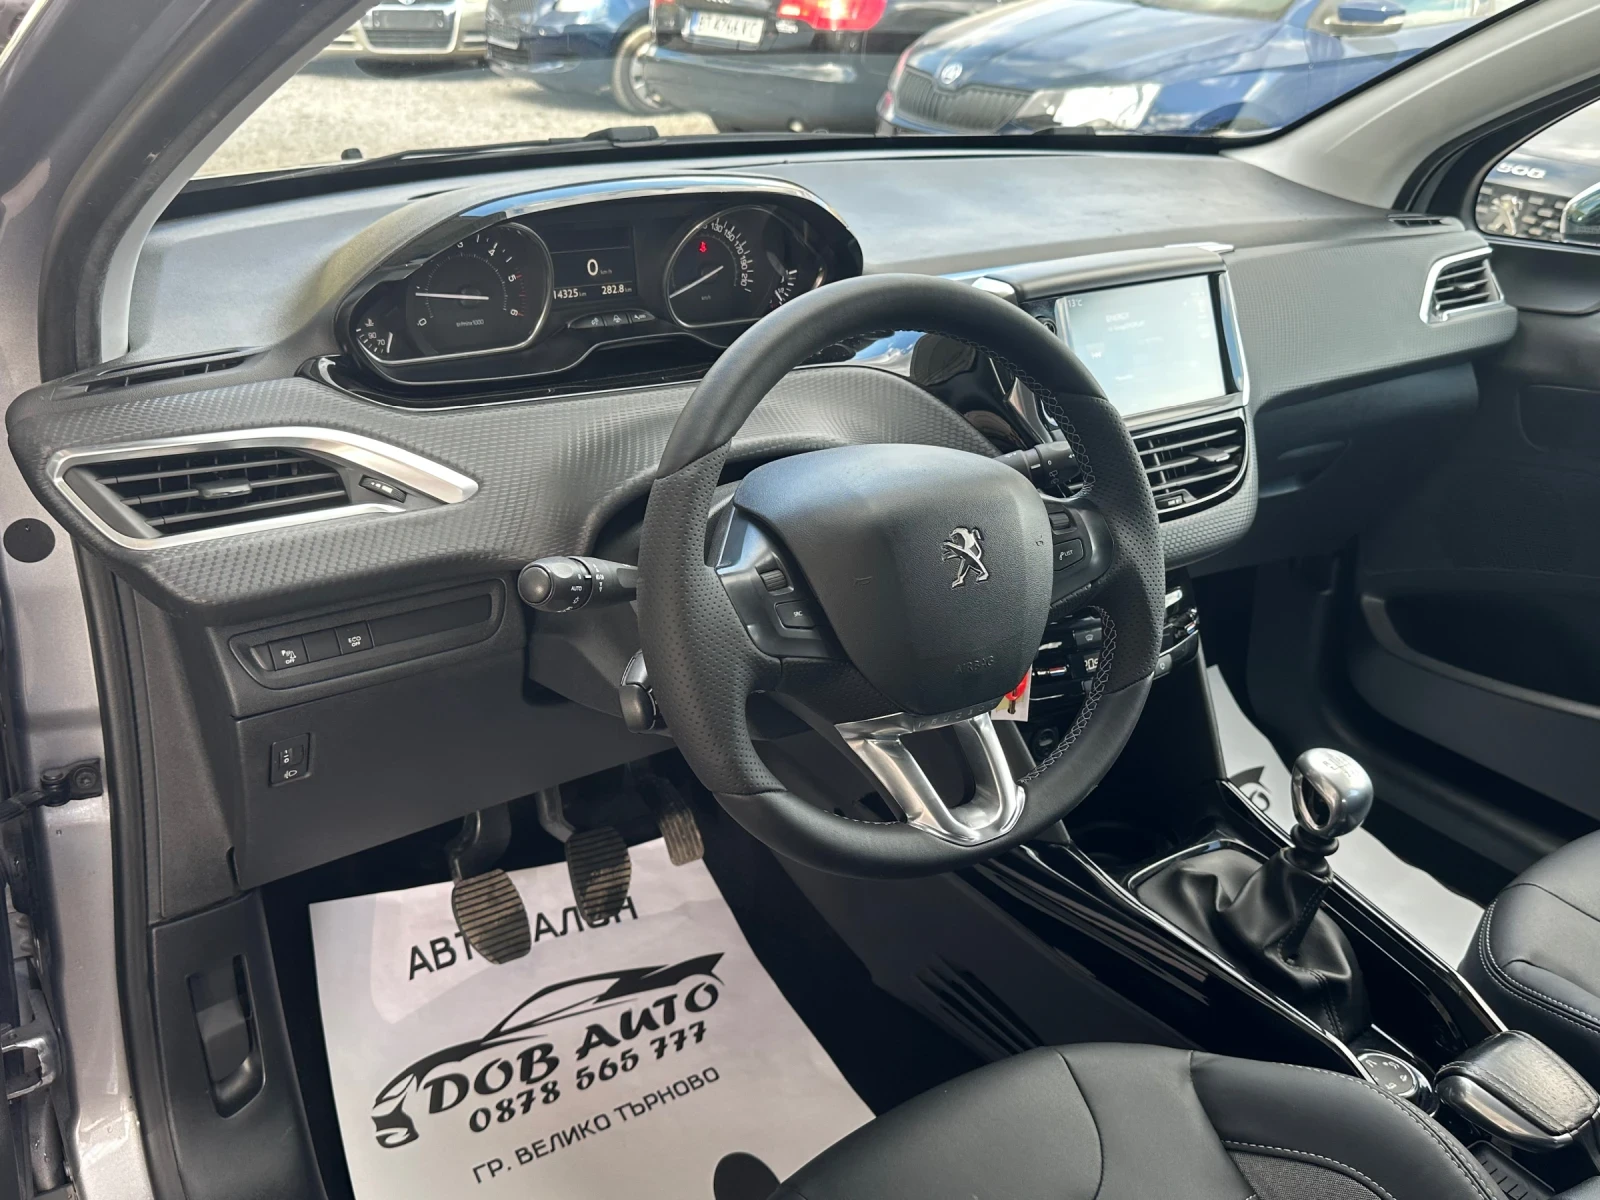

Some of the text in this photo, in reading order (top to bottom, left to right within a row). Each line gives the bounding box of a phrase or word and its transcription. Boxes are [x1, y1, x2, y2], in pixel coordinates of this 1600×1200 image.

[488, 248, 496, 257] 4
[587, 258, 599, 276] 0
[508, 274, 517, 282] 5
[601, 284, 624, 295] 282.8
[510, 308, 519, 317] 6
[376, 338, 386, 346] 70
[409, 895, 638, 981] АВТАЛН
[468, 1020, 707, 1133] 0878 565 777
[472, 1066, 720, 1184] ГР. ВЕЛИКО ТЪРНОВО
